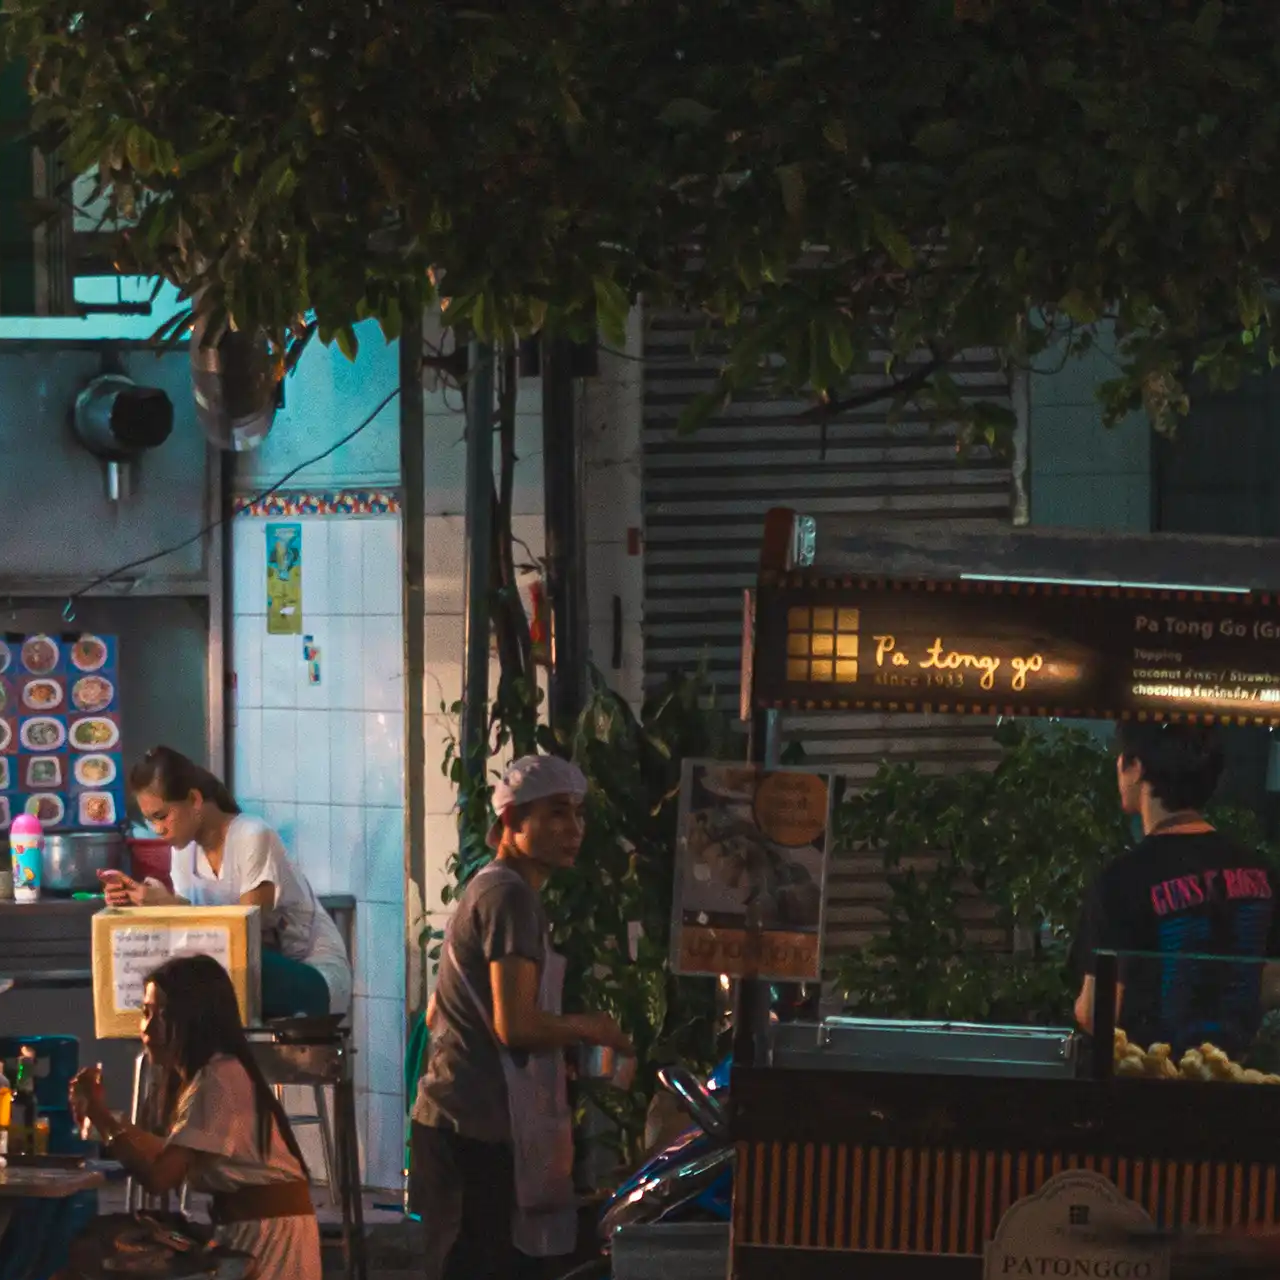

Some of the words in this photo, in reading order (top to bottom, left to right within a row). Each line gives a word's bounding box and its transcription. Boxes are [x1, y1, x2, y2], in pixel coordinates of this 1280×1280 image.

[1134, 615, 1159, 632] Pa
[1164, 616, 1214, 640] Tong
[1219, 617, 1247, 637] Go
[872, 634, 909, 667] Pa
[919, 636, 1001, 691] tong
[1010, 653, 1044, 691] go
[1132, 683, 1192, 698] chocolate
[1002, 1255, 1152, 1279] PATONGGO
